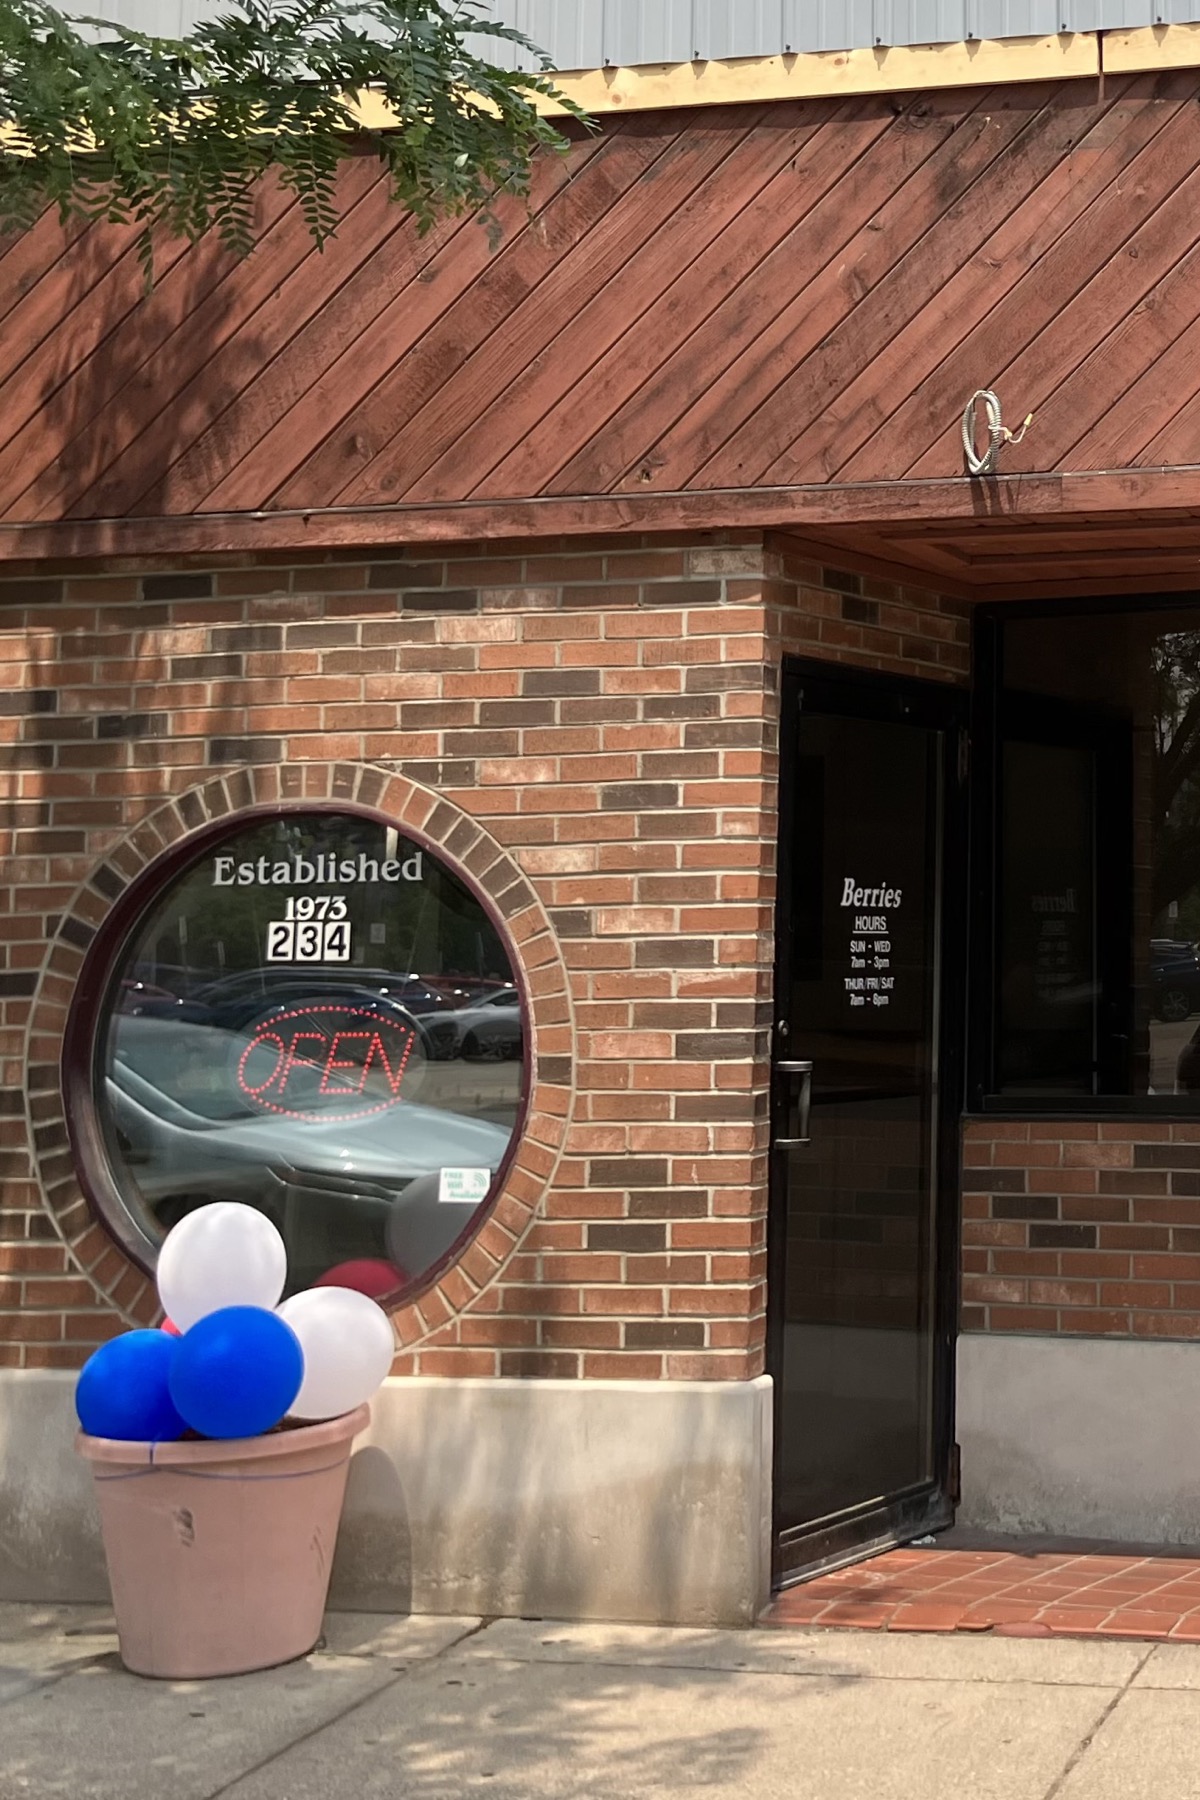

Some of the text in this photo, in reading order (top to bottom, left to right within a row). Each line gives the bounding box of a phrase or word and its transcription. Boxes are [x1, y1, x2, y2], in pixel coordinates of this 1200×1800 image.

[211, 851, 424, 886] Established
[840, 877, 902, 908] Berries
[284, 895, 348, 921] 1973
[855, 916, 887, 931] HOURS
[271, 925, 347, 958] 234
[850, 940, 866, 953] SUN
[874, 940, 891, 953] WED
[851, 956, 866, 968] 7am
[874, 956, 890, 970] 3pm
[850, 993, 865, 1006] 7am
[237, 1031, 416, 1095] OPEN
